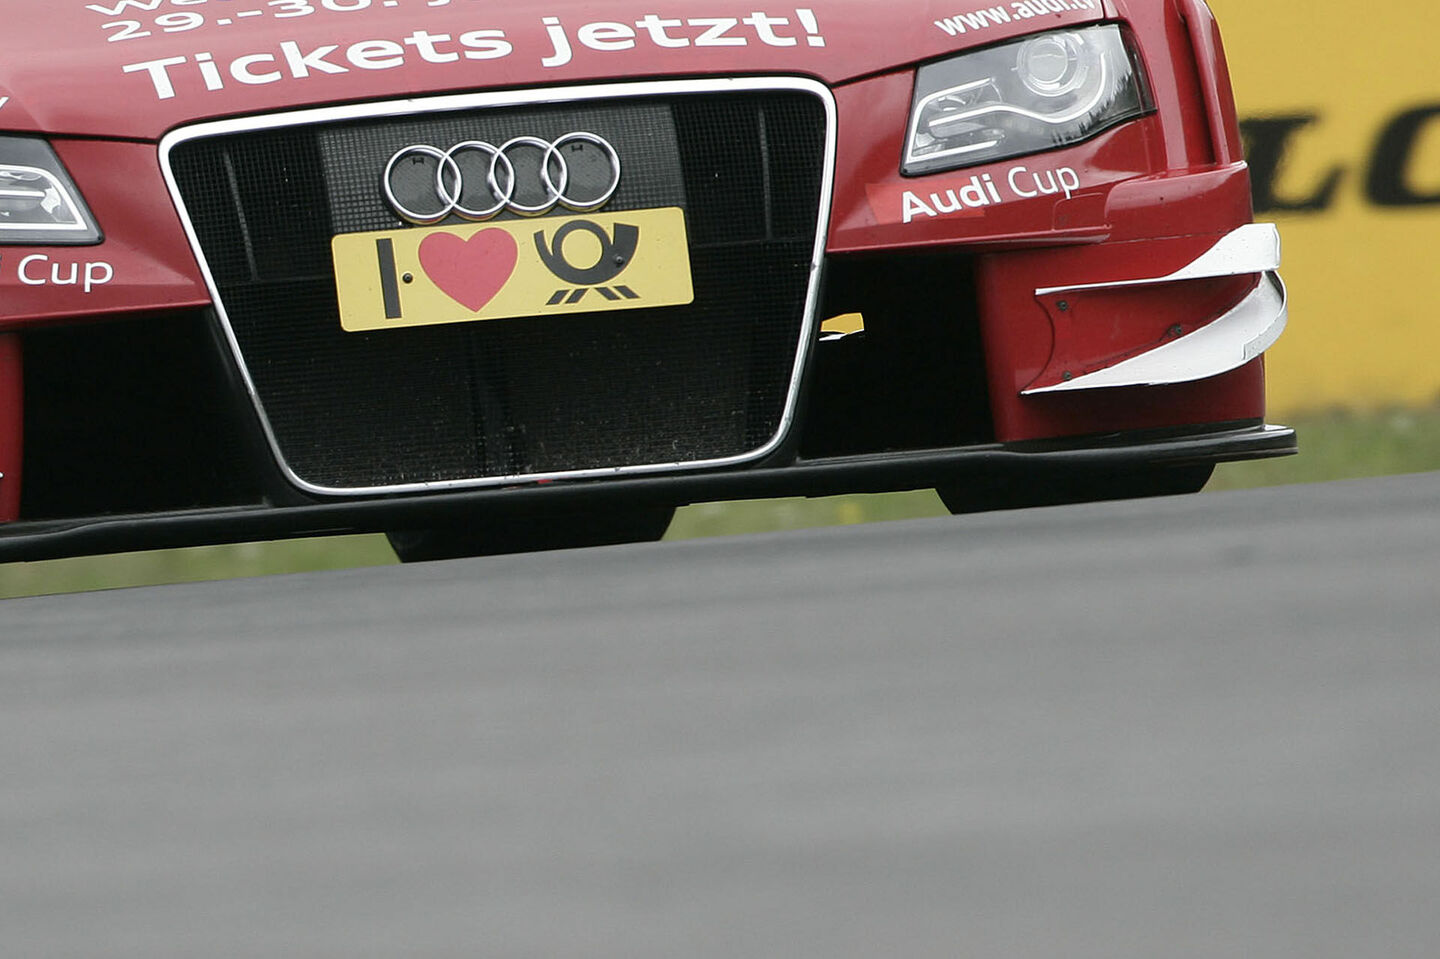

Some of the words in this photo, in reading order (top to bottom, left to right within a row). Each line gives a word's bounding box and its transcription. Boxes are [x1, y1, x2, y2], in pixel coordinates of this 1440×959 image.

[122, 29, 513, 100] Tickets
[541, 8, 826, 68] jetzt!
[901, 172, 1002, 224] Audi
[1009, 166, 1080, 200] Cup
[17, 254, 114, 293] Cup
[375, 237, 403, 320] I
